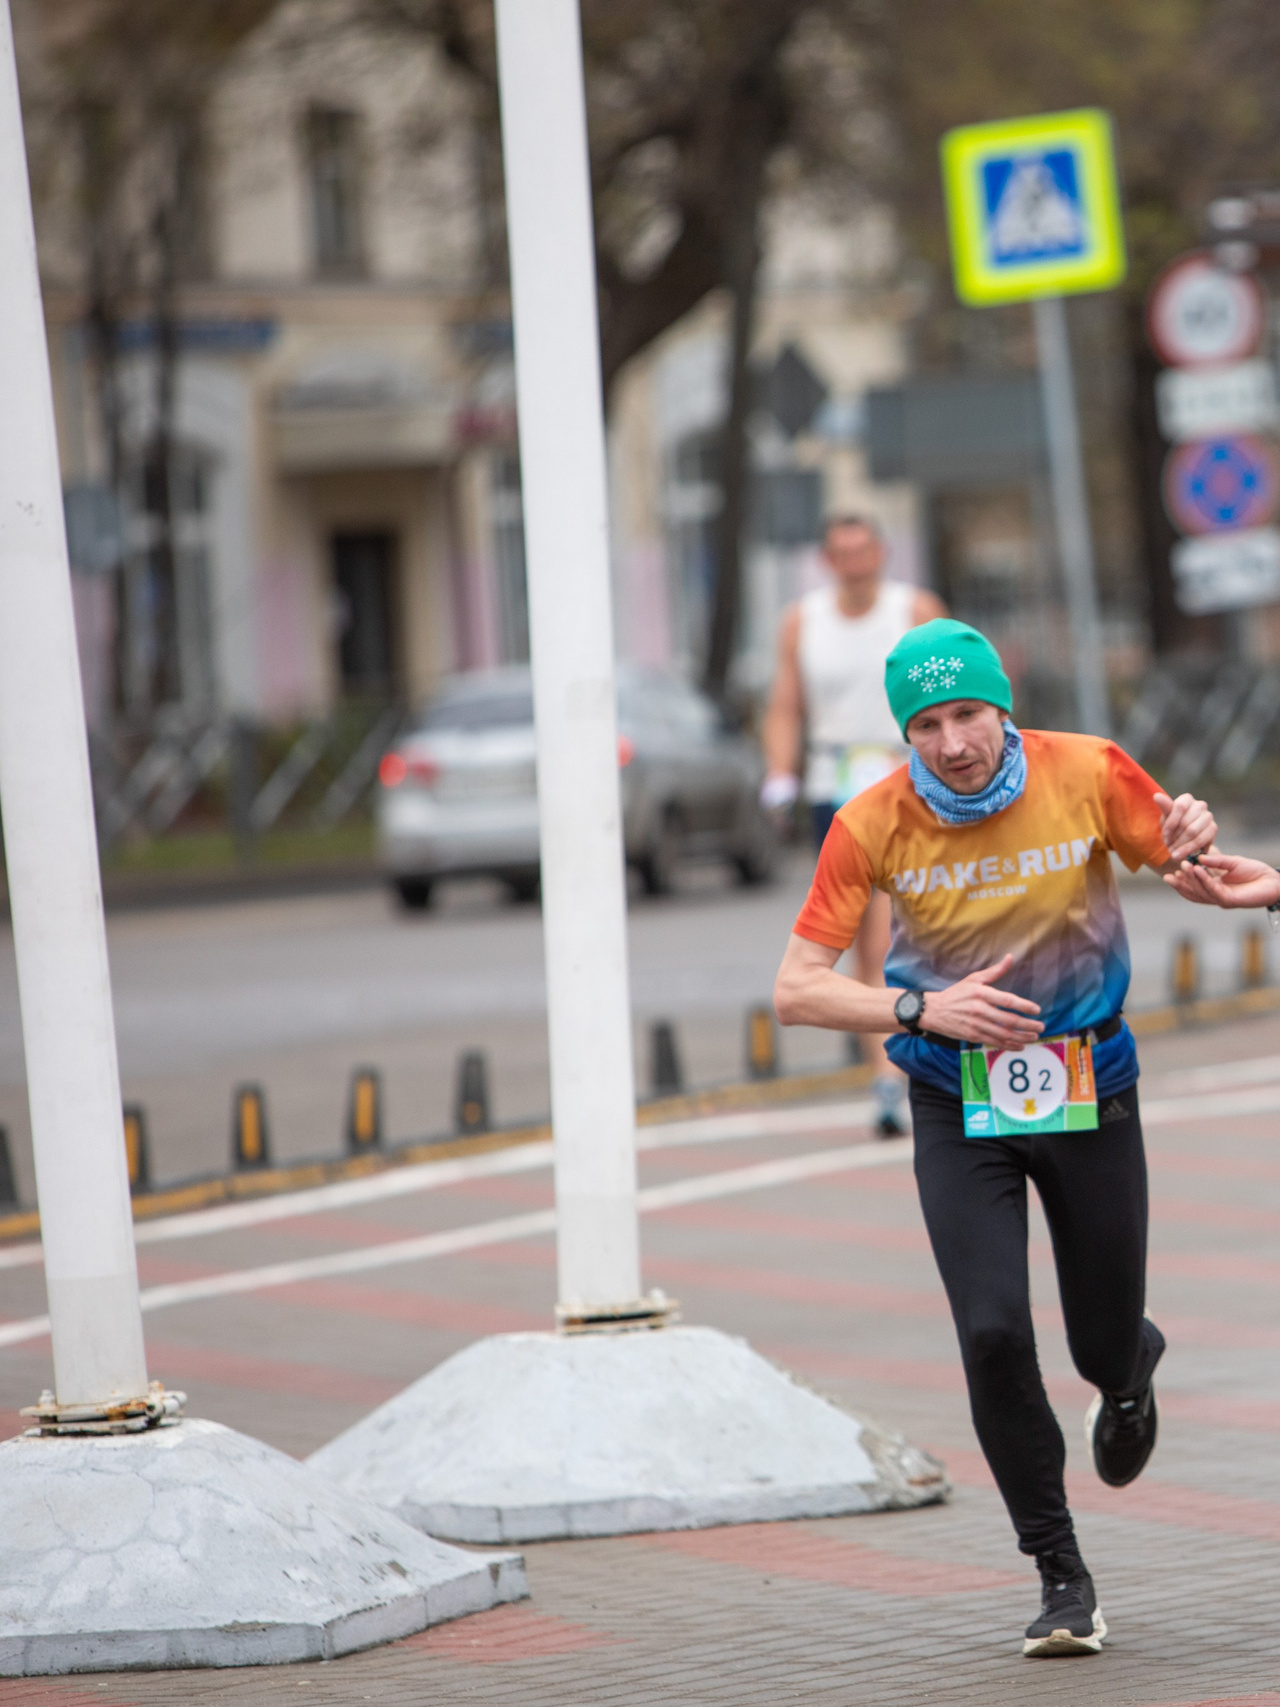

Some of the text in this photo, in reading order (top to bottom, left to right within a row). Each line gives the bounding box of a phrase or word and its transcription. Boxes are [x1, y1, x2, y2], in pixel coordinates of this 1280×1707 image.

[967, 884, 1027, 900] MOSCOW
[1008, 1058, 1030, 1093] 8
[1038, 1069, 1052, 1092] 2
